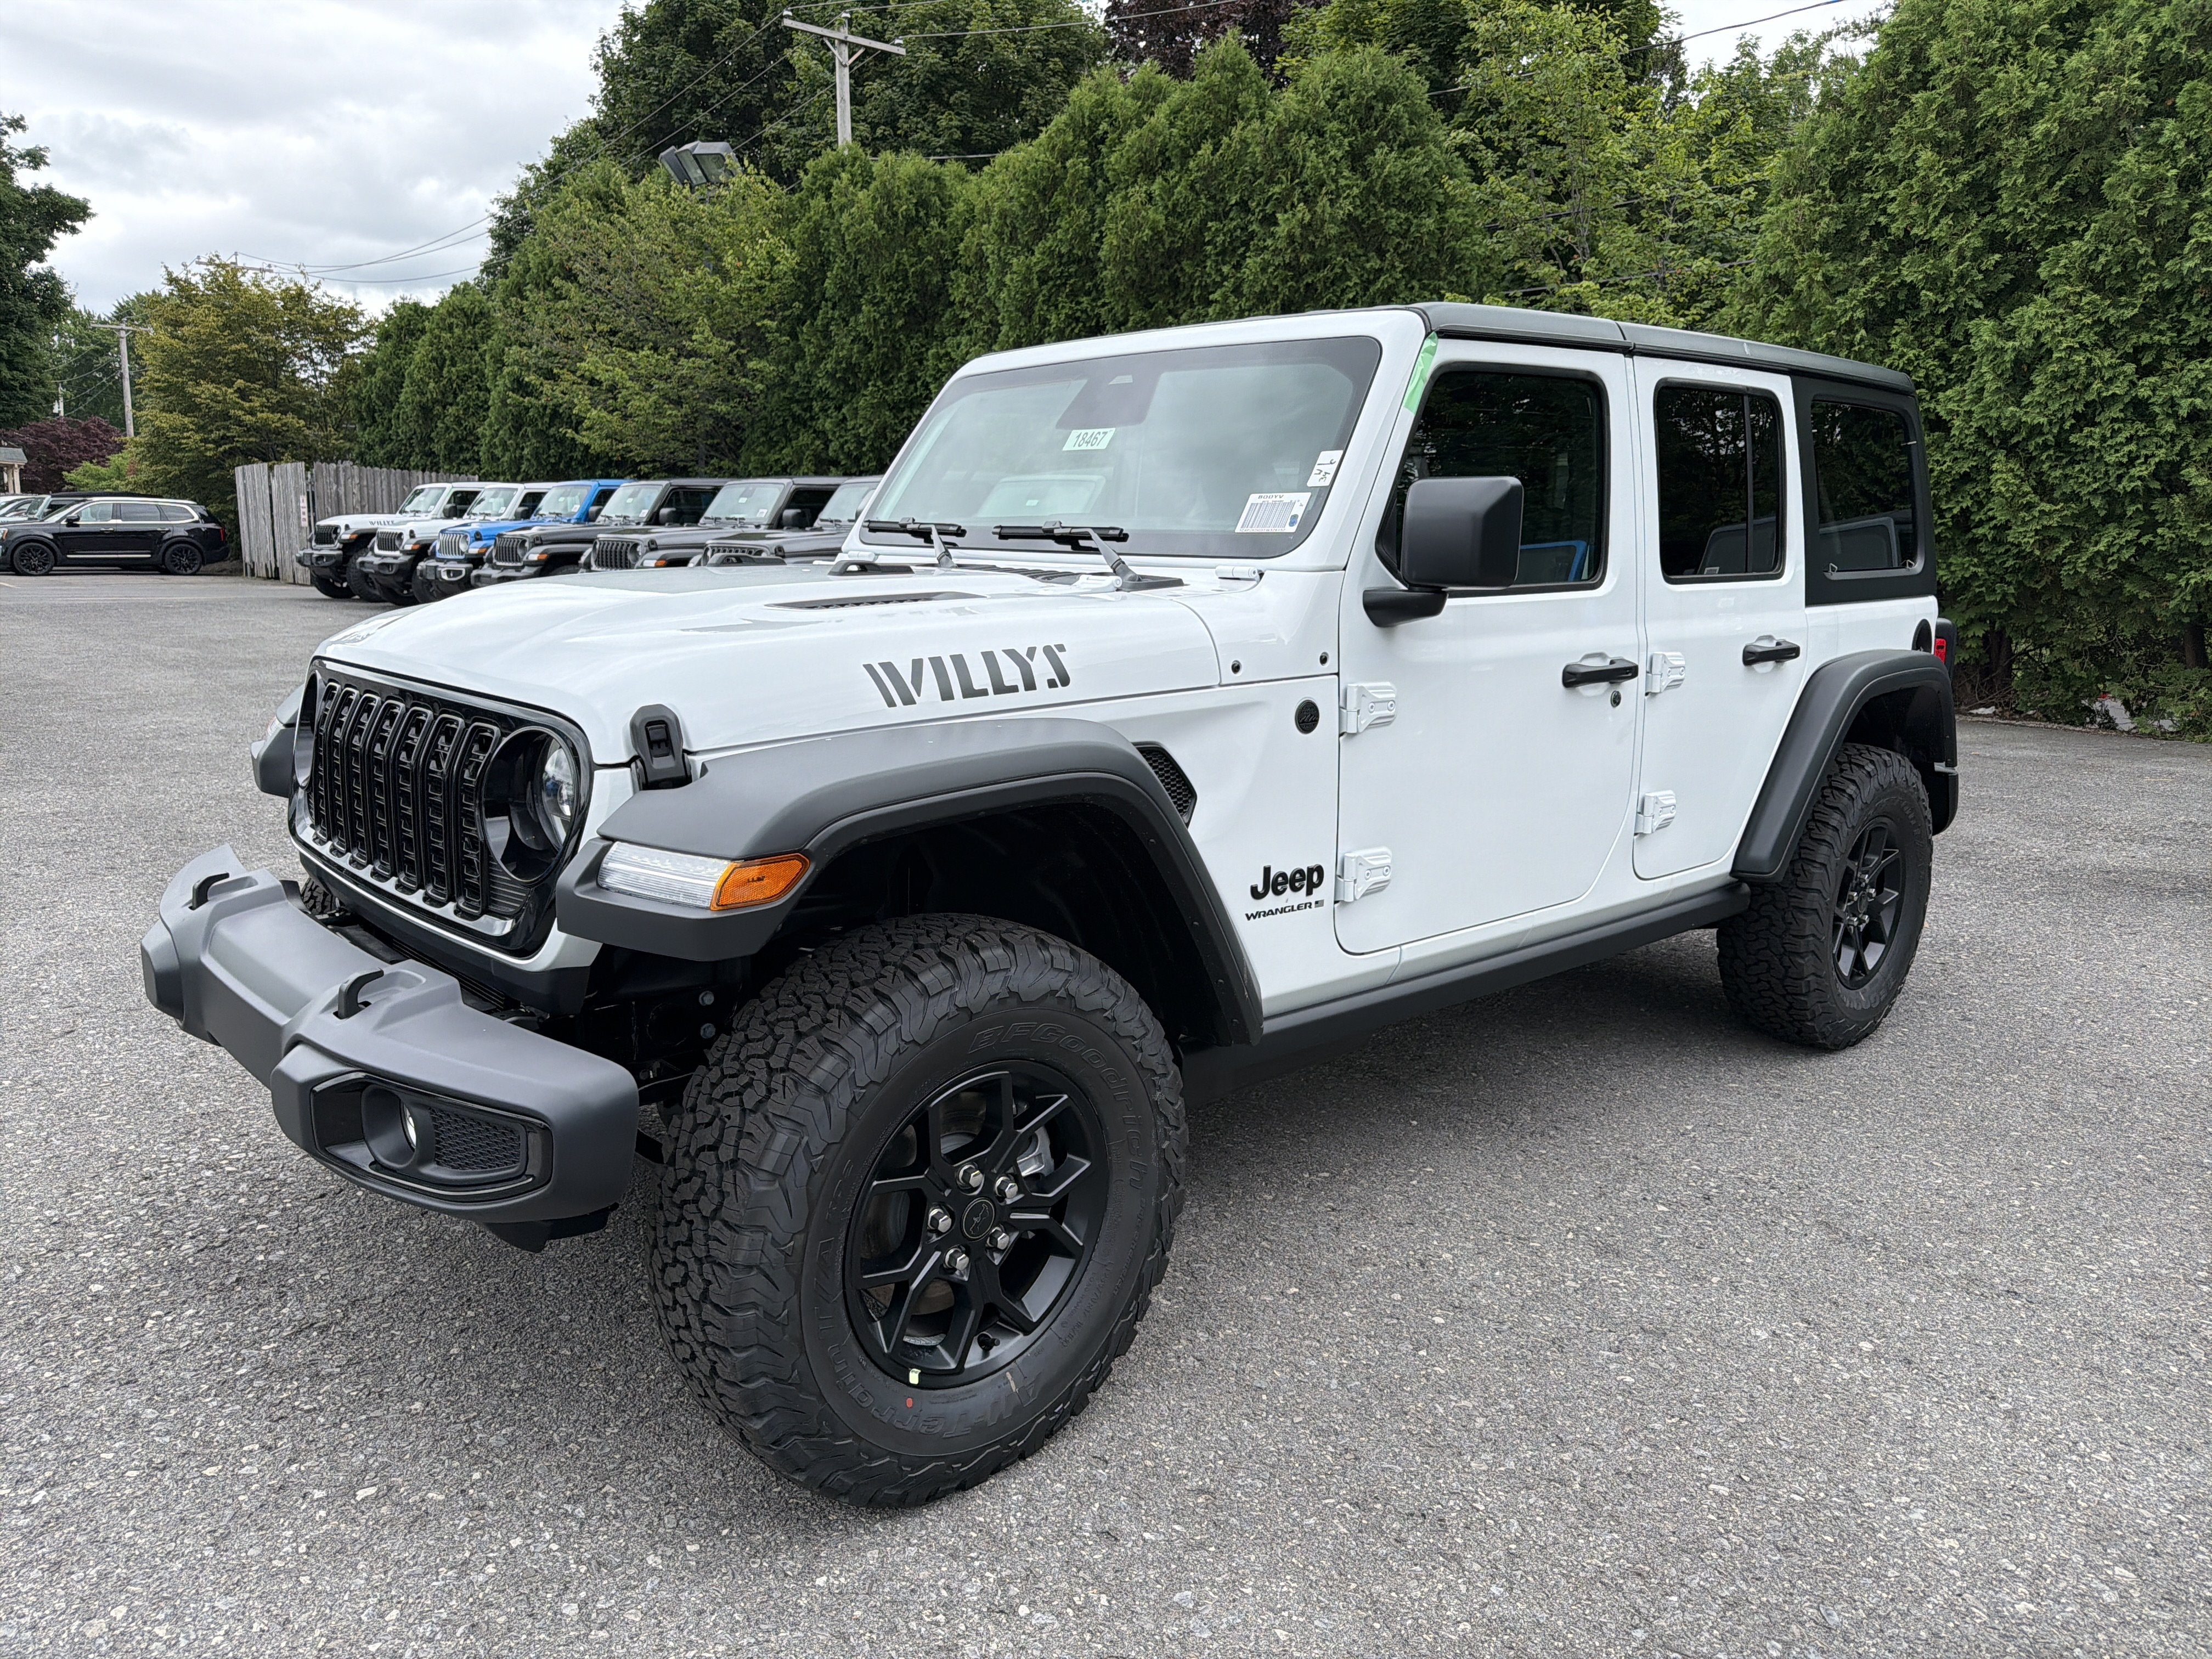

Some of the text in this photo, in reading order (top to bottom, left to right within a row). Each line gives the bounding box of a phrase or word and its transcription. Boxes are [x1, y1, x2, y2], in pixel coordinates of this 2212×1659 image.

[1073, 431, 1108, 448] 18467
[862, 644, 1071, 708] WILLYS
[1250, 864, 1324, 900] Jeep
[1245, 901, 1312, 921] WRANGLER
[968, 1022, 1147, 1191] BFGoodrich
